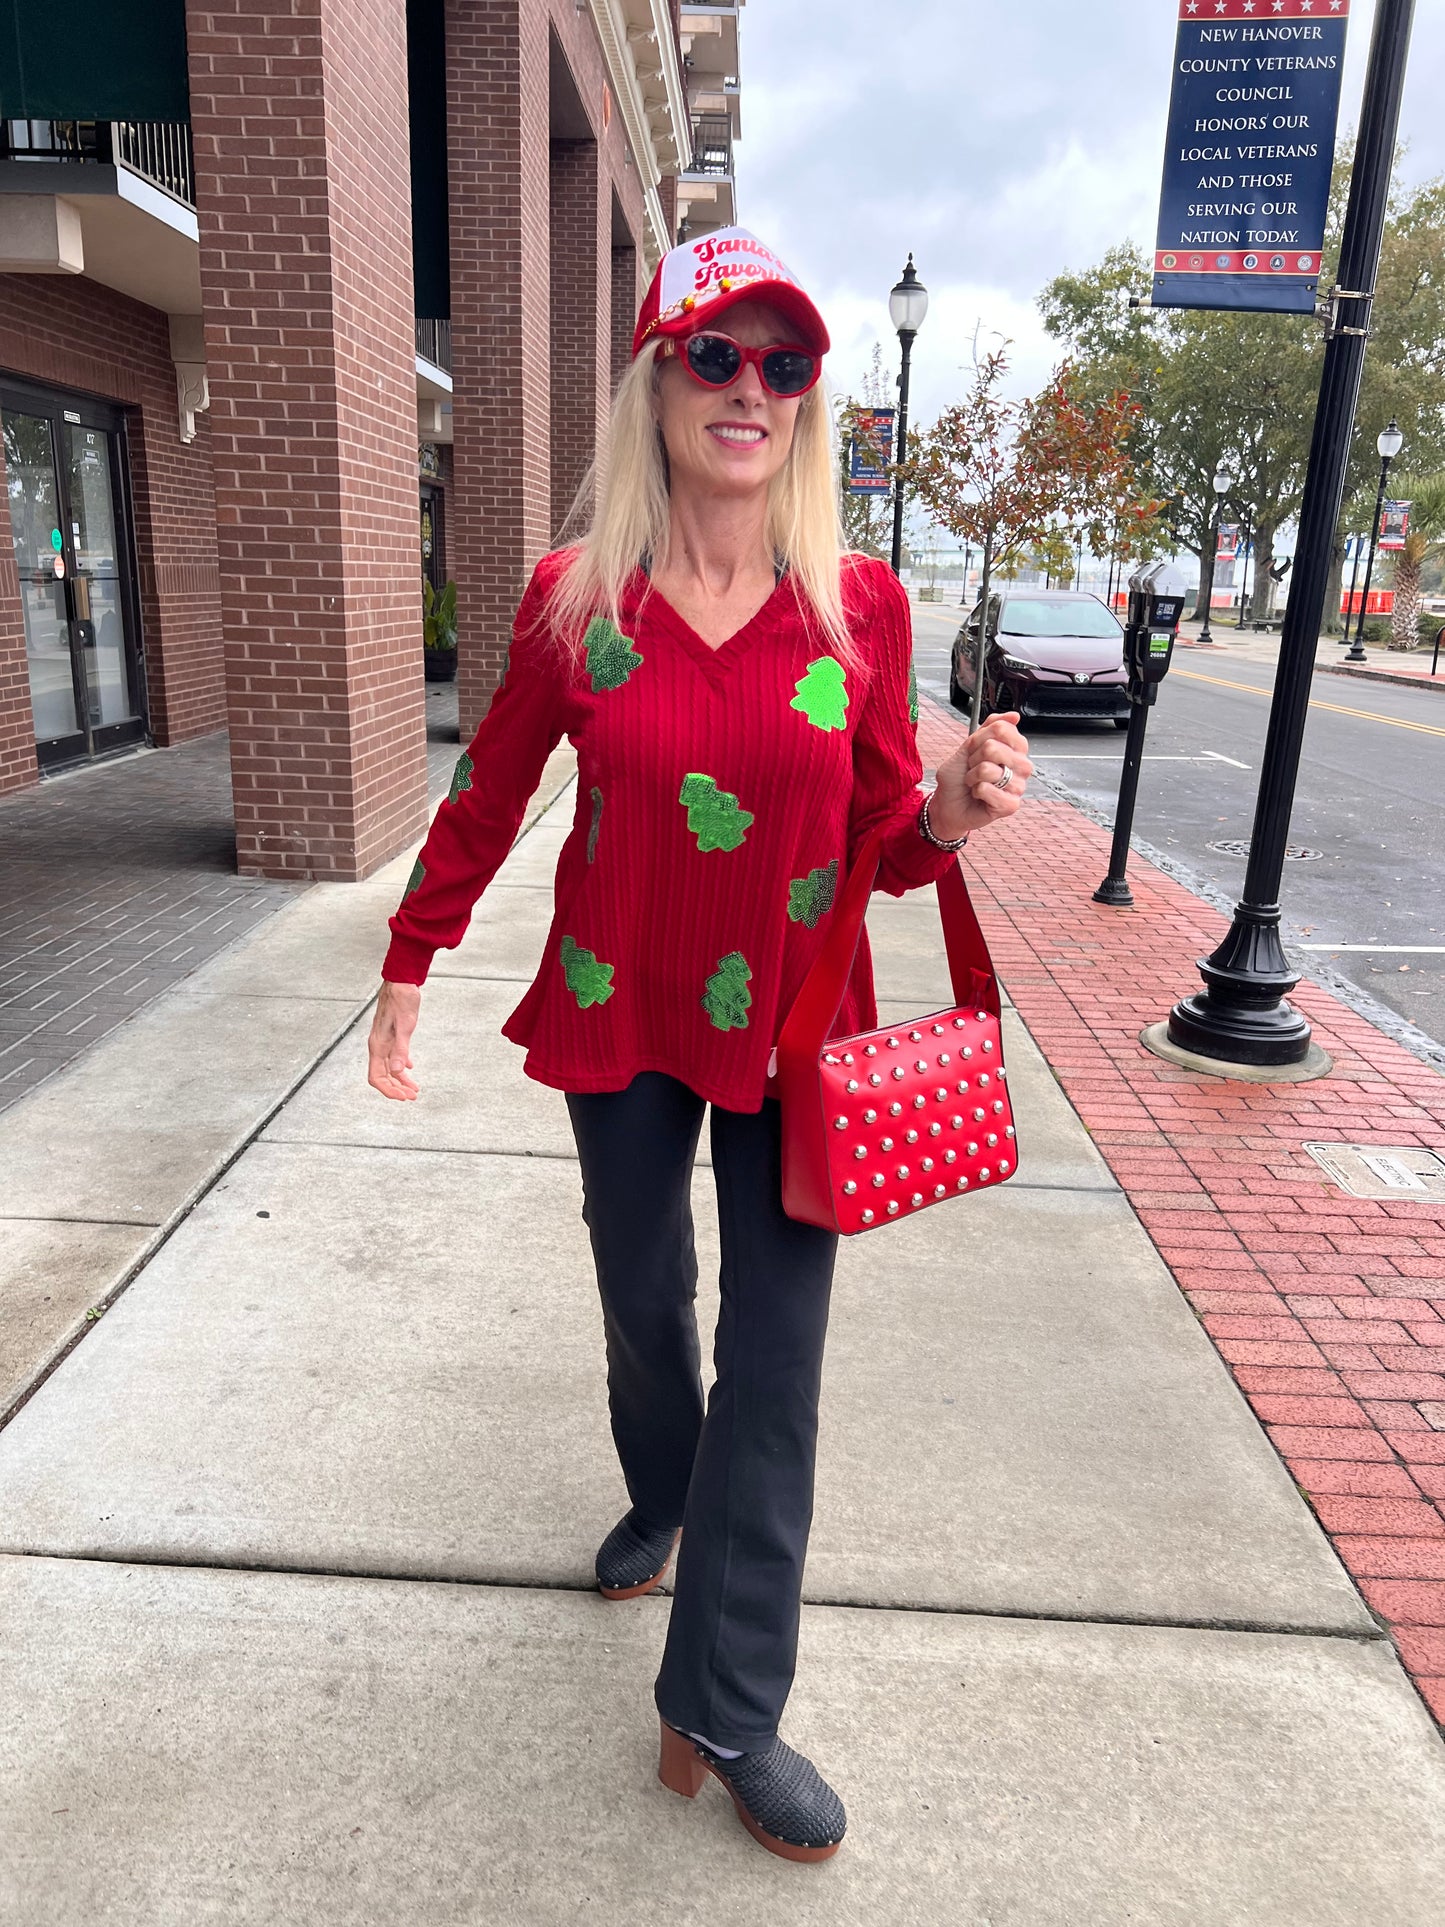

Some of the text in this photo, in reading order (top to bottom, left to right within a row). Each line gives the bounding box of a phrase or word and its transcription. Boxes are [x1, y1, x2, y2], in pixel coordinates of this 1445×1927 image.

[1199, 26, 1323, 43] NEW HANOVER
[1179, 55, 1337, 74] COUNTY VETERANS
[1215, 86, 1293, 102] COUNCIL
[1194, 115, 1310, 132] HONORS OUR
[1180, 143, 1318, 162] LOCAL VETERANS
[1196, 173, 1293, 189] AND THOSE
[1187, 201, 1298, 217] SERVING OUR
[1180, 229, 1299, 244] NATION TODAY.
[693, 237, 785, 270] Santas
